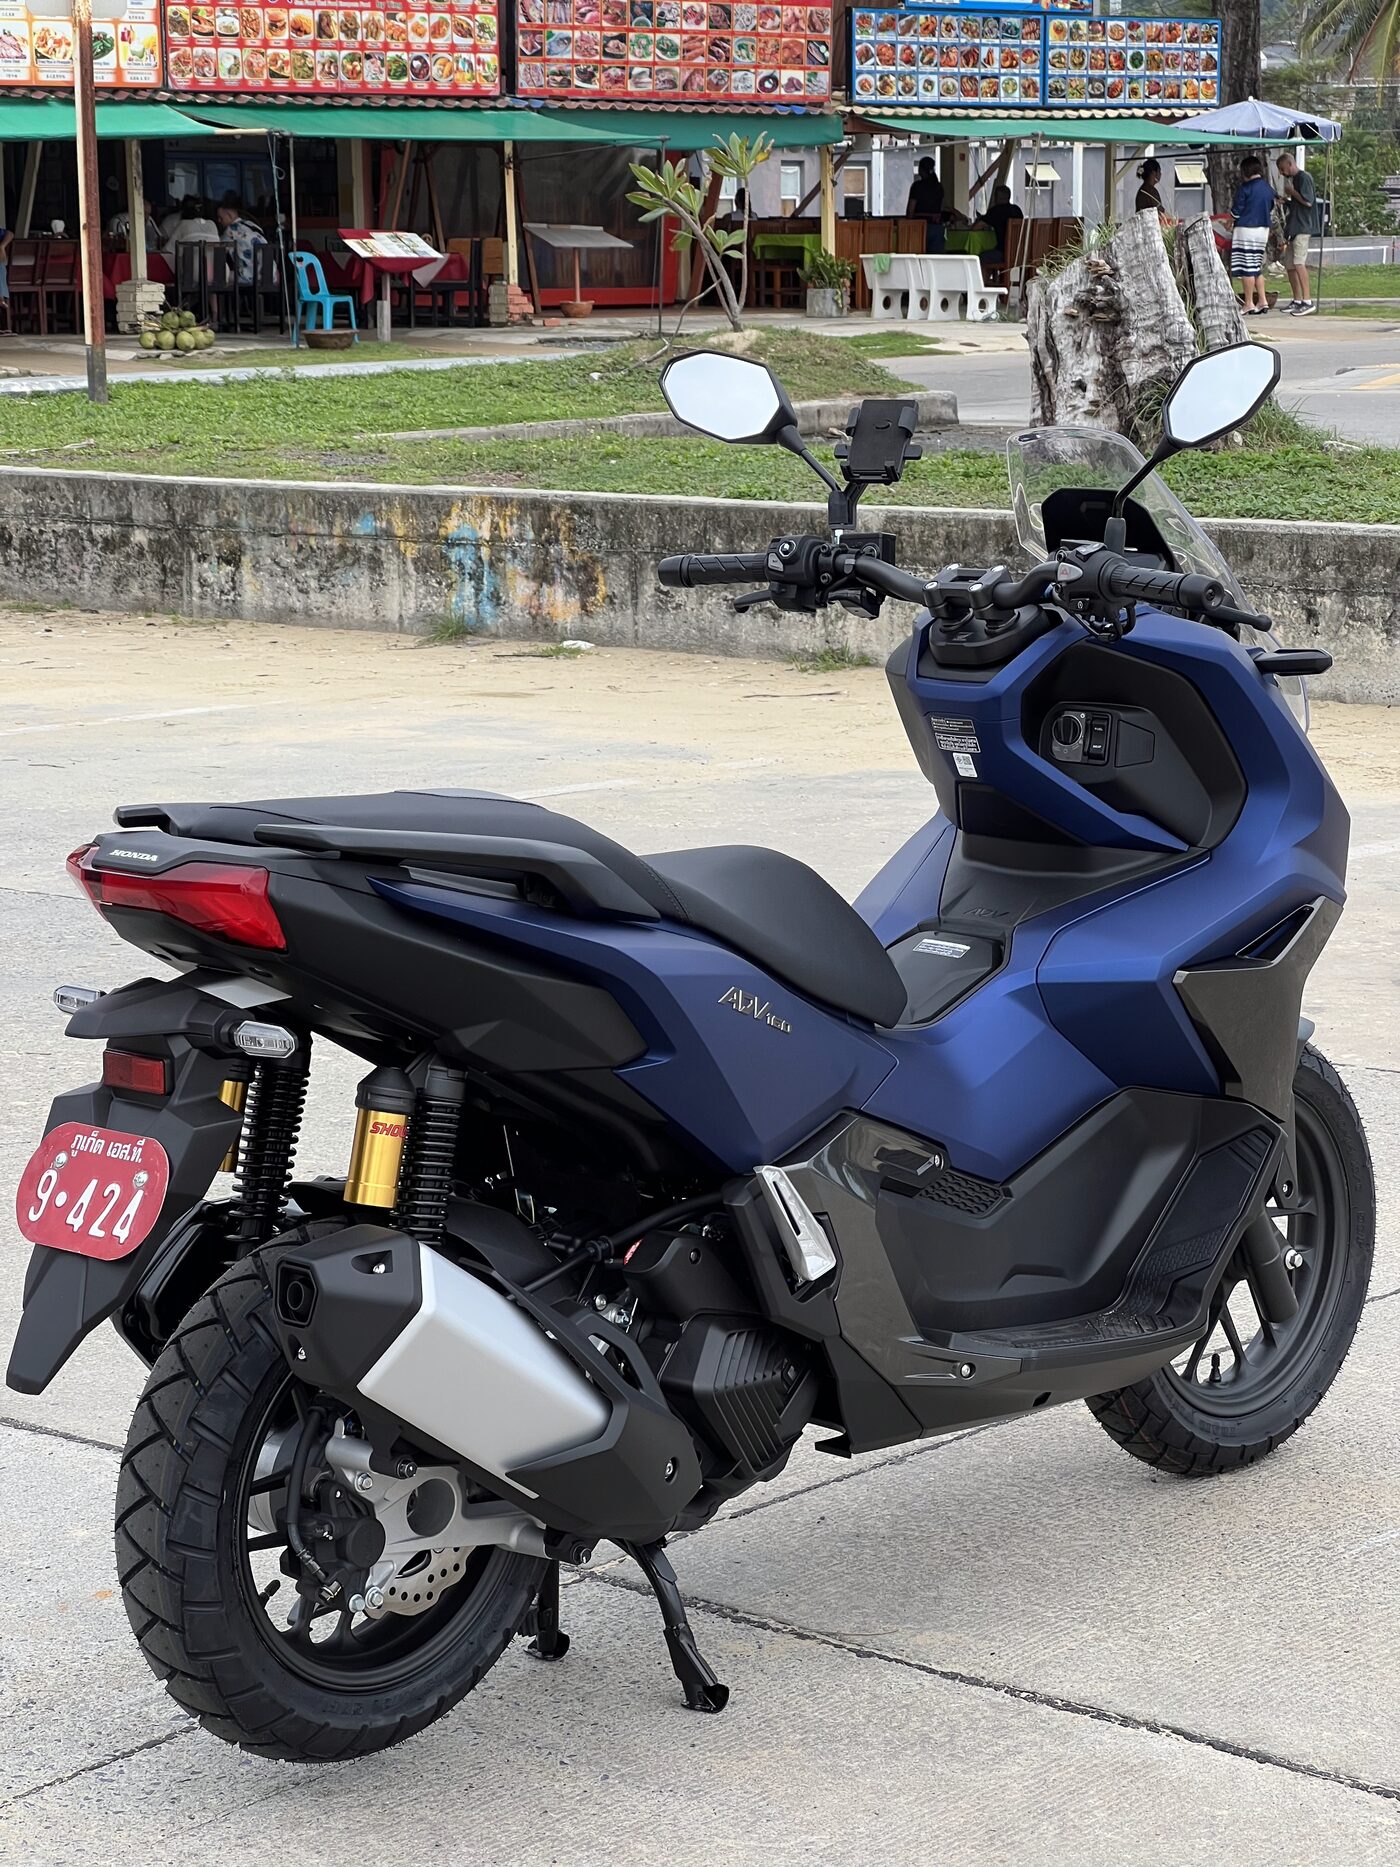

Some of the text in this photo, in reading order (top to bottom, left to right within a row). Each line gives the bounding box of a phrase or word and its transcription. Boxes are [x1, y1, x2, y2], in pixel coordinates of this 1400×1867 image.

[109, 849, 159, 862] HONDA
[70, 1130, 105, 1157] ภูเก็ต
